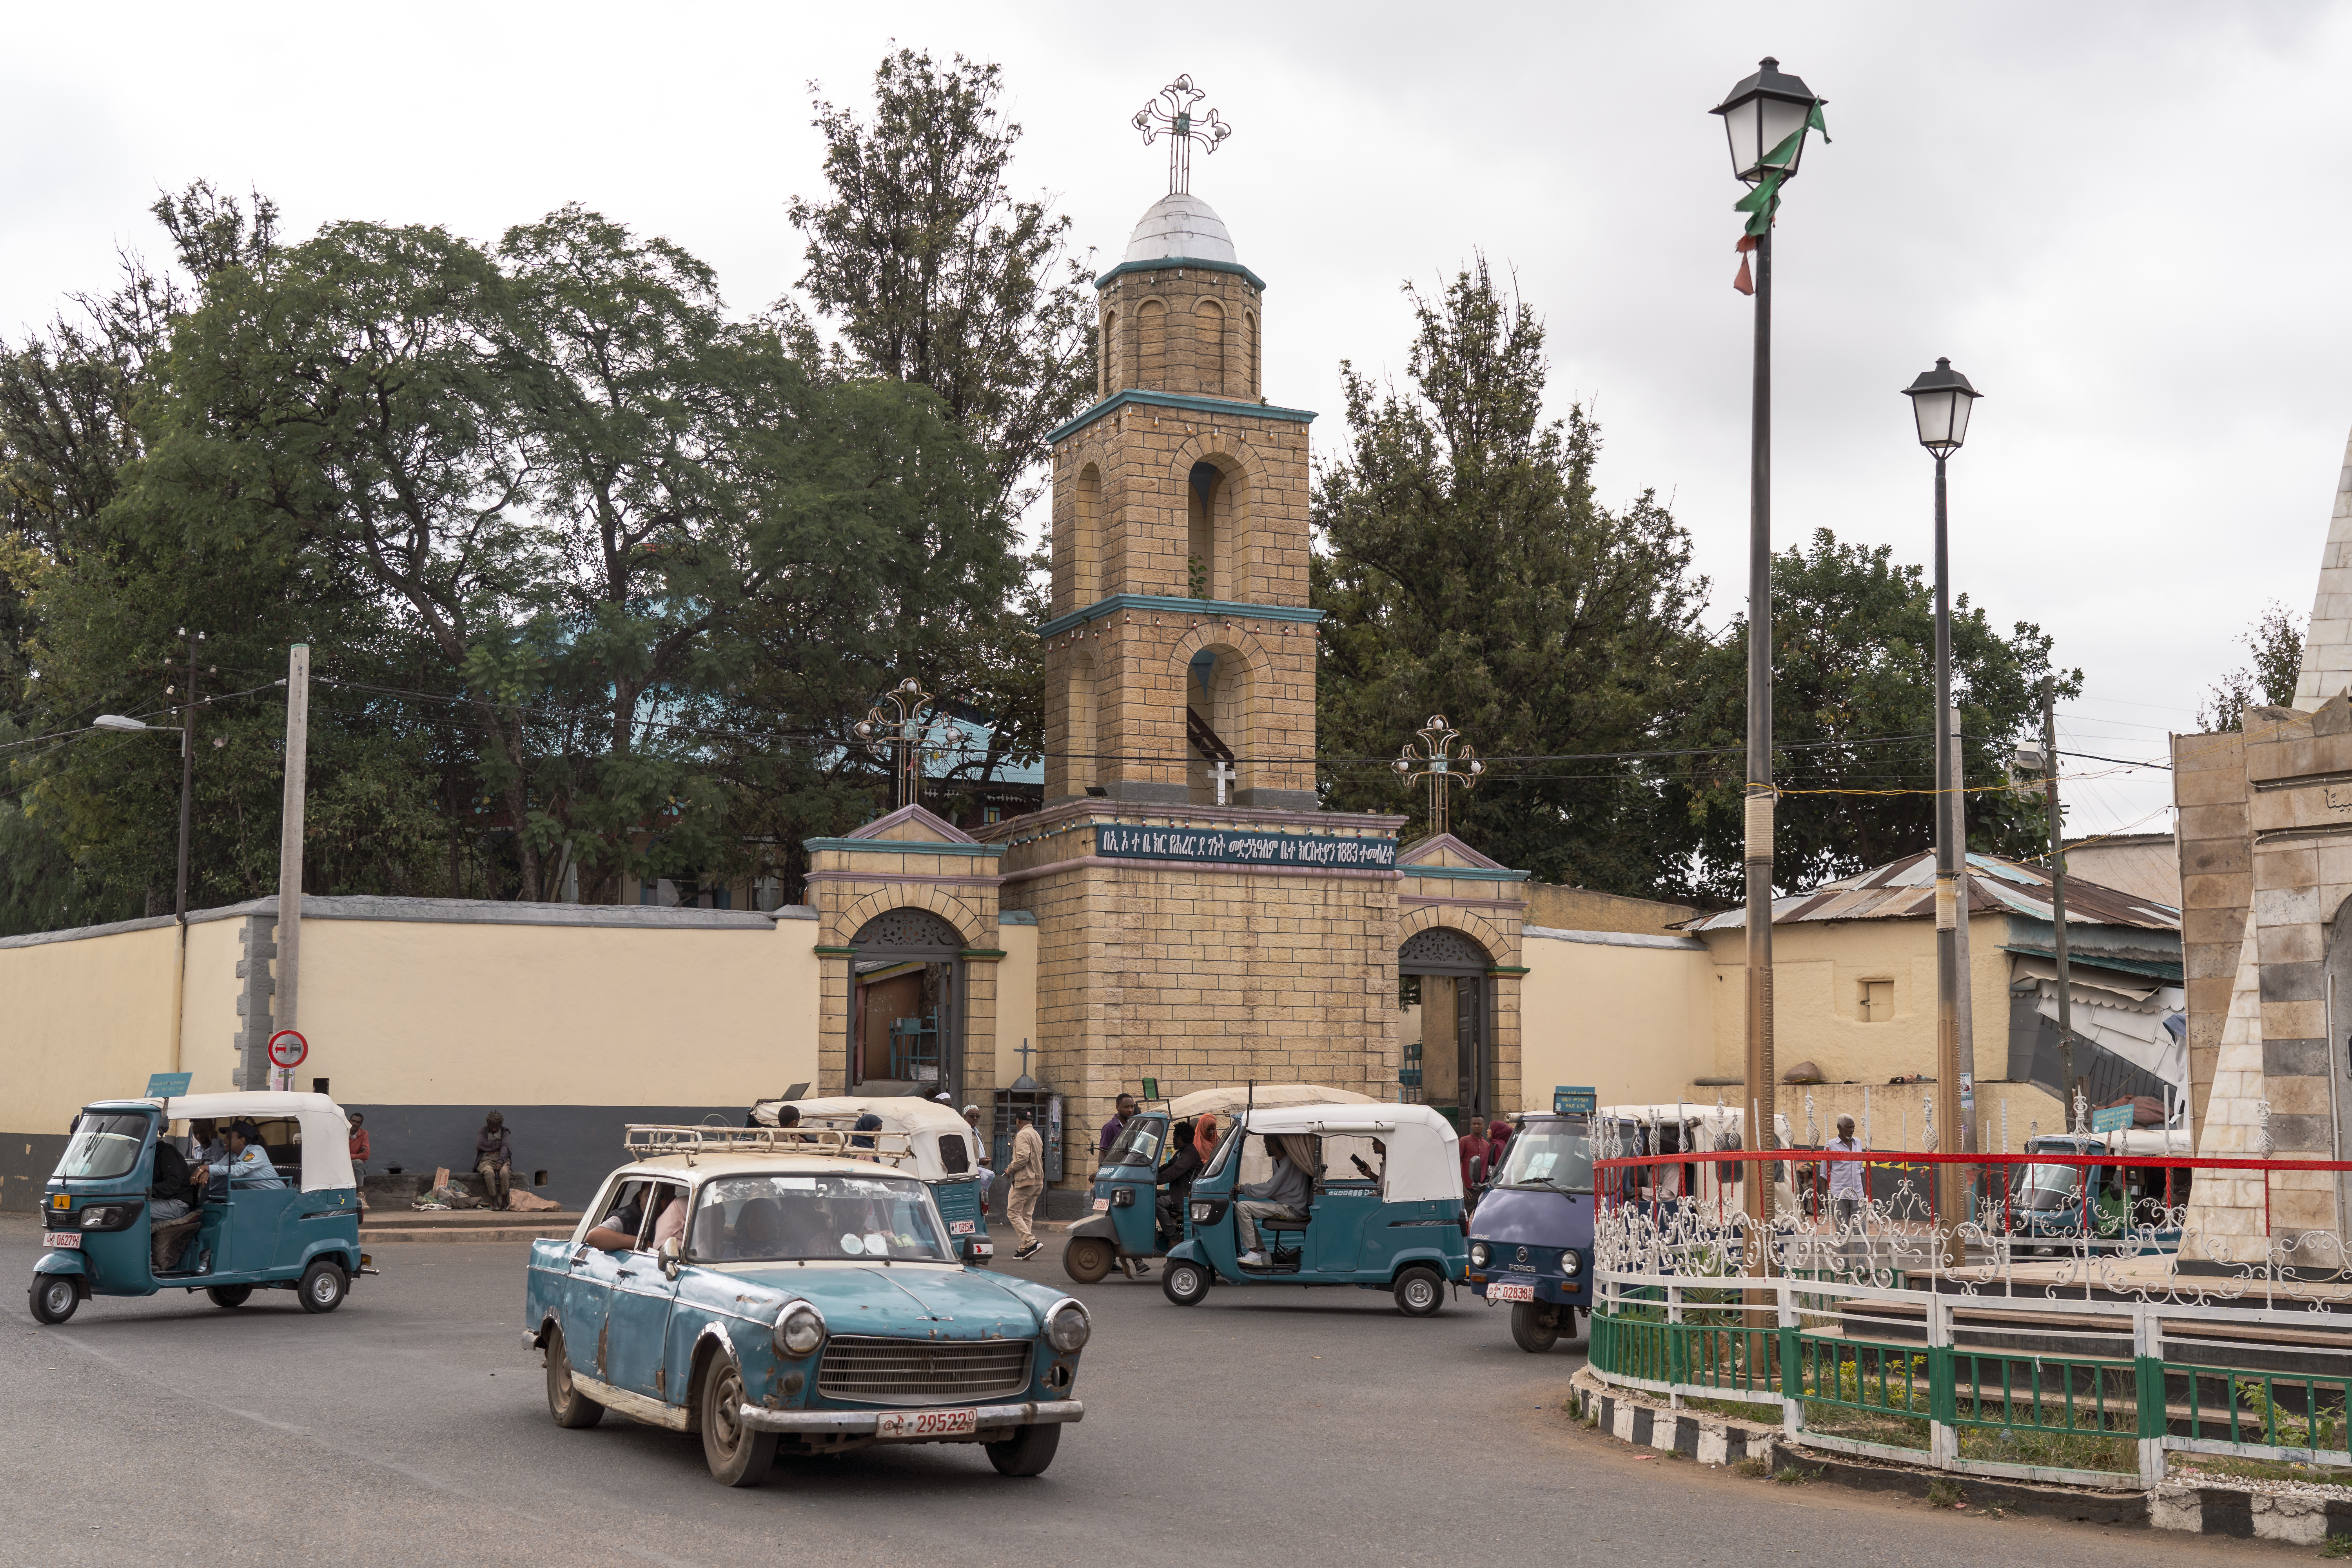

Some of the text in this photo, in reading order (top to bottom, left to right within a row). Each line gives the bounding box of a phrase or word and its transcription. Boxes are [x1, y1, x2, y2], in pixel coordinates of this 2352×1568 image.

[2323, 788, 2352, 813] بينًا
[1103, 830, 1118, 852] በኢ
[1131, 833, 1140, 852] ተ
[1142, 833, 1151, 853] ቤ
[1153, 833, 1167, 854] ክር
[1280, 841, 1296, 860] ቤተ
[1298, 840, 1335, 864] ክርስቲያን
[1337, 842, 1358, 862] 1883
[57, 1234, 76, 1246] 06279
[1509, 1264, 1536, 1272] FORCE
[1503, 1287, 1528, 1299] 02838
[916, 1412, 966, 1432] 29522
